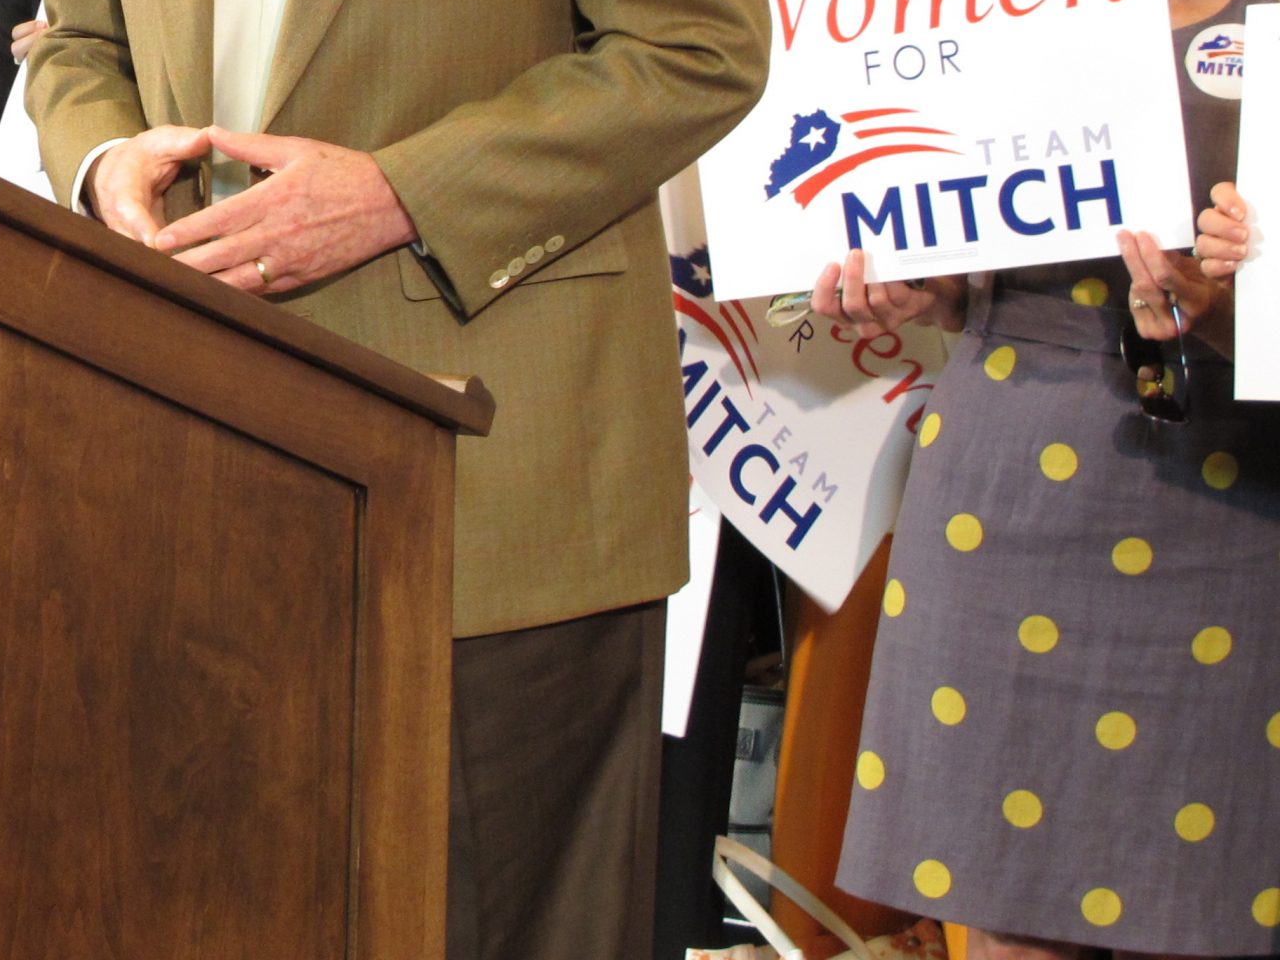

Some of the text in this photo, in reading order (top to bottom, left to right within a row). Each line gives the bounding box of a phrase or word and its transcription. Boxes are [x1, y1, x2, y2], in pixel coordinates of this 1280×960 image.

[863, 40, 962, 86] FOR
[975, 123, 1113, 166] TEAM
[841, 159, 1124, 251] MITCH
[755, 401, 840, 504] TEAM
